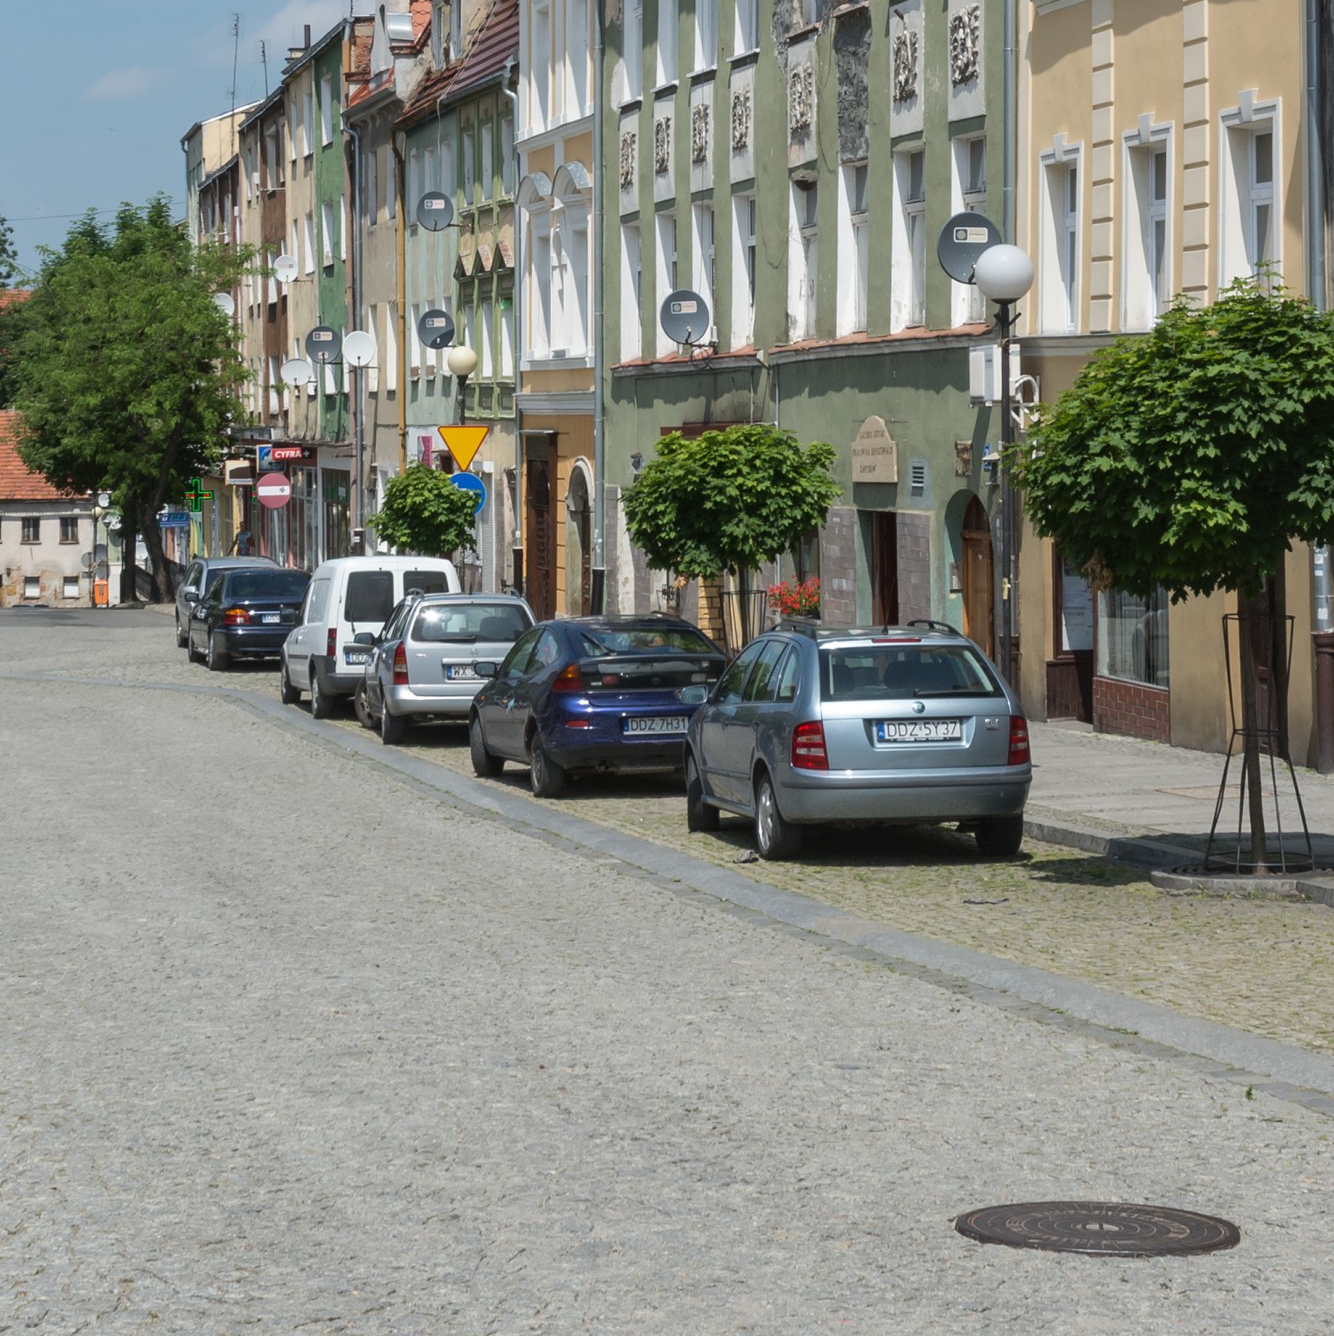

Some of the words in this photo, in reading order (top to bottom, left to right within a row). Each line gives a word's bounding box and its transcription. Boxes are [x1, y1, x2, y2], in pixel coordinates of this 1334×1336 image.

[630, 718, 655, 731] DDZ
[659, 717, 686, 731] 7H31
[887, 722, 918, 737] DDZ
[924, 721, 957, 736] 5Y37
